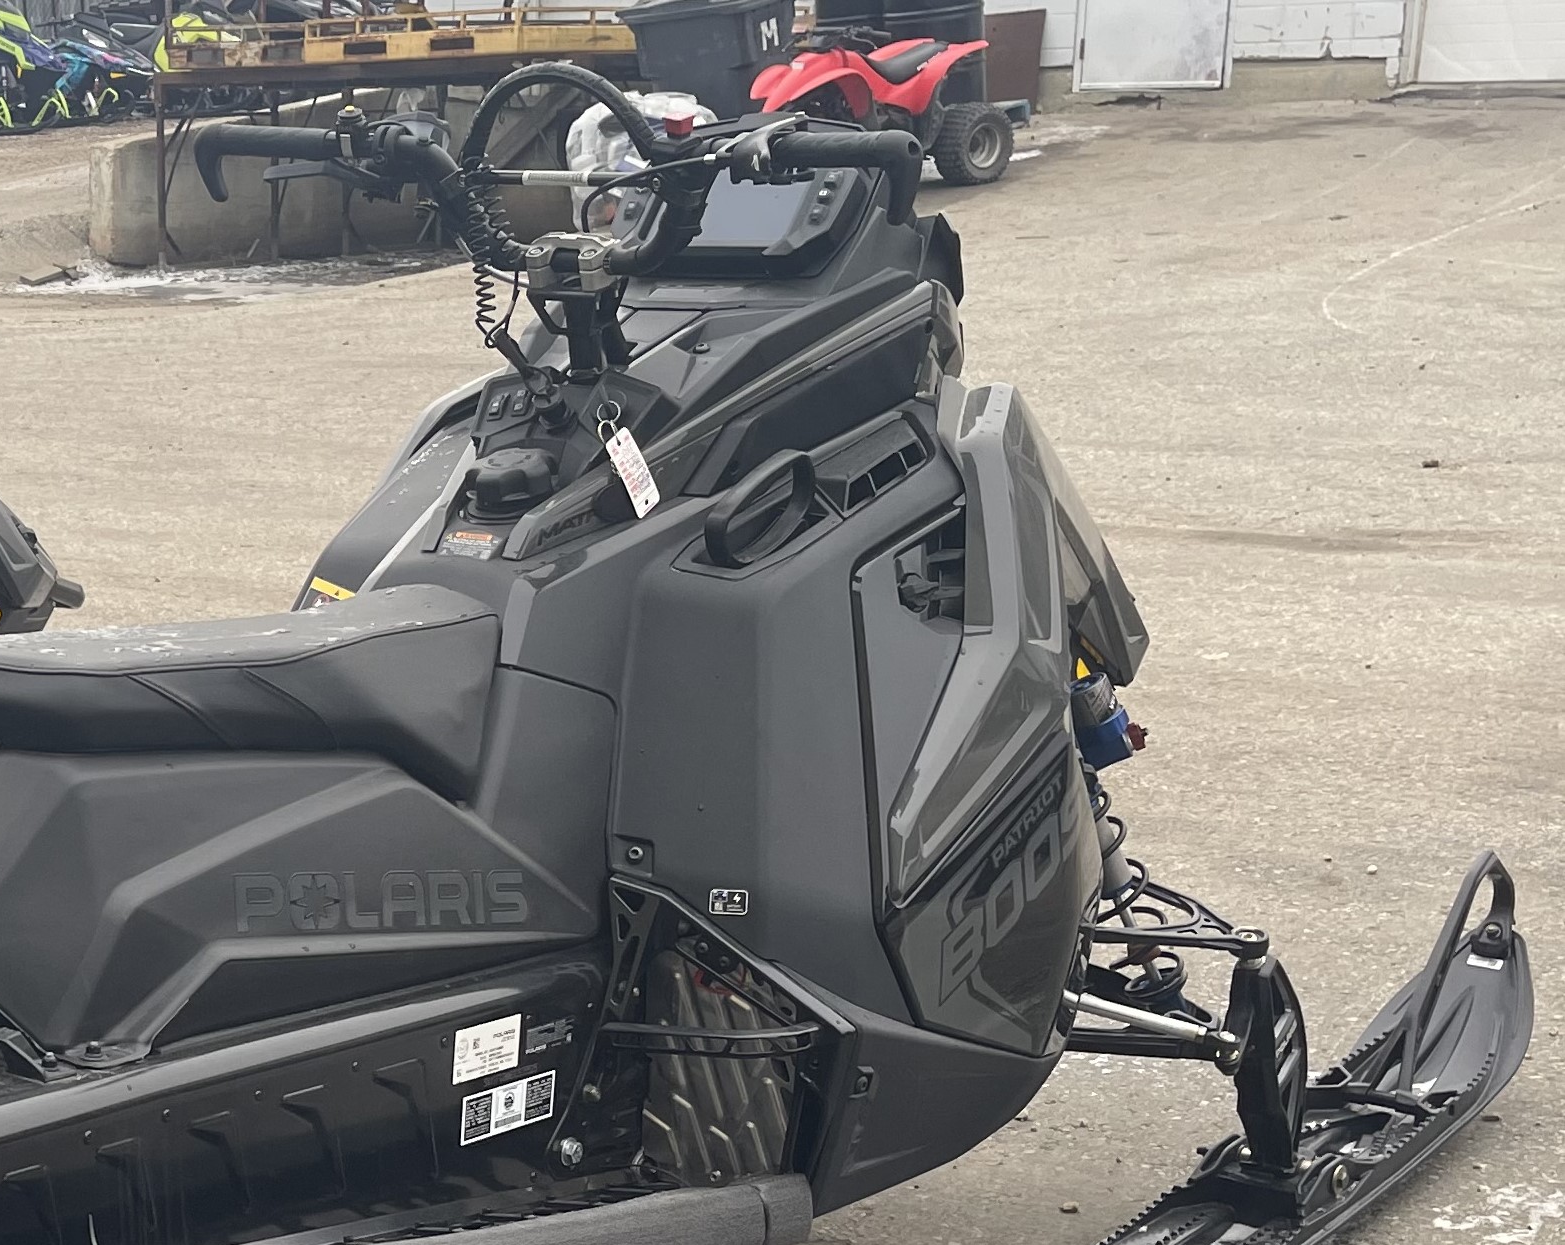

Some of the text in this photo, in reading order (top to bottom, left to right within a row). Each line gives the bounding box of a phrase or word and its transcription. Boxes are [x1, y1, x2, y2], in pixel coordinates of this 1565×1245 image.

[759, 17, 780, 51] M
[990, 772, 1064, 869] PATRIOT
[233, 870, 528, 932] POLARIS
[939, 786, 1081, 1007] BOOS
